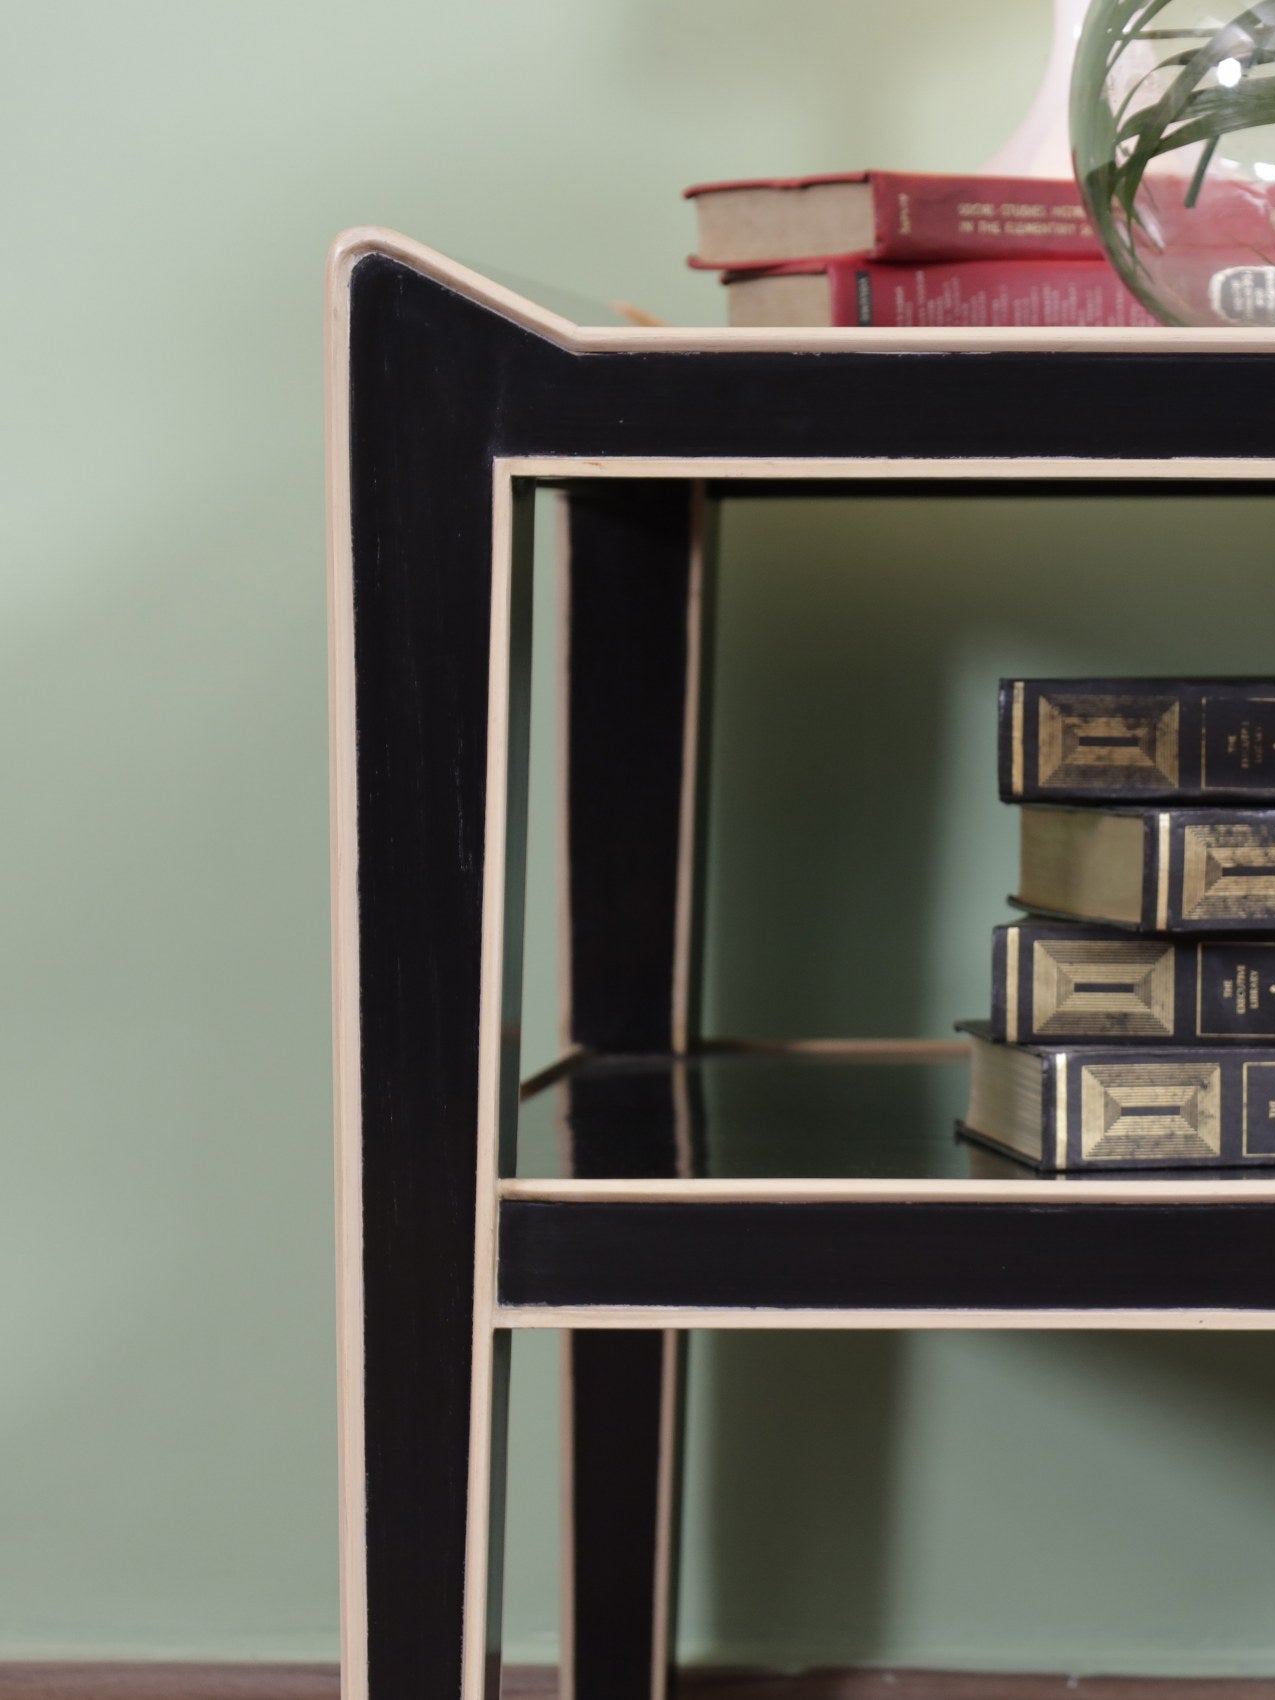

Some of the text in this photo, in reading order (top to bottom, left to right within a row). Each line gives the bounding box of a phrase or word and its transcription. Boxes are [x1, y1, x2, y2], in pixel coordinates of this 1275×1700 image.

[1223, 979, 1233, 998] THE
[1236, 965, 1246, 1015] EXECUTIVE
[1249, 970, 1259, 1009] LIBRARY
